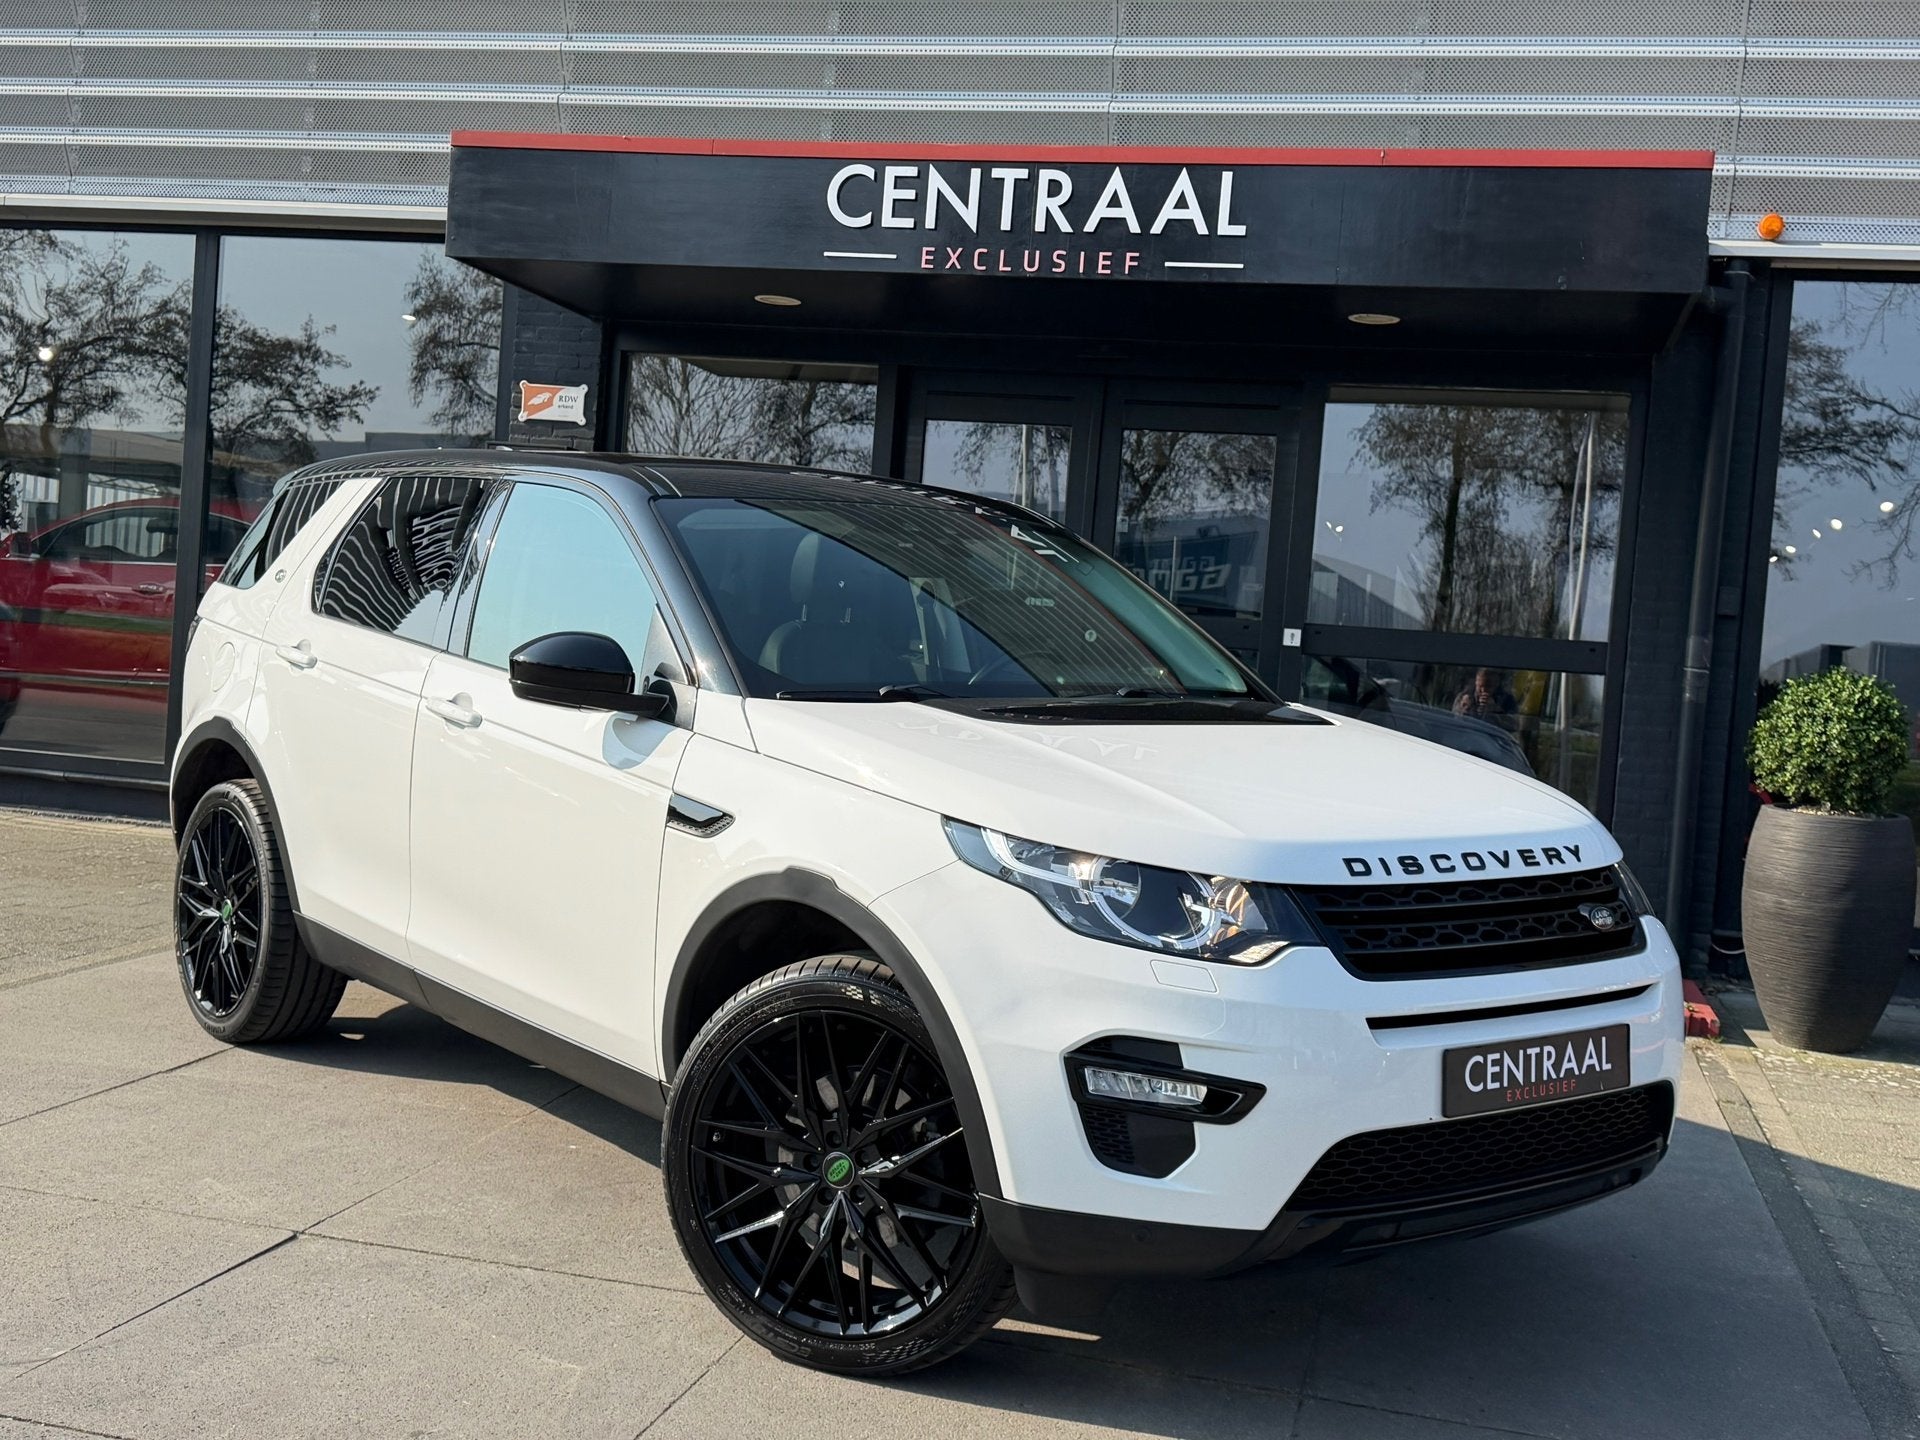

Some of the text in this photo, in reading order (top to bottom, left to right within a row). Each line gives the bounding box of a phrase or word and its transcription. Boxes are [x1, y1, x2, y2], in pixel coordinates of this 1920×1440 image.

[826, 163, 1247, 236] CENTRAAL
[921, 246, 1140, 275] EXCLUSIEF
[558, 395, 579, 403] RDW
[1342, 845, 1582, 877] DISCOVERY
[1465, 1036, 1612, 1093] CENTRAAL
[1506, 1079, 1577, 1102] EXCLUSIEF
